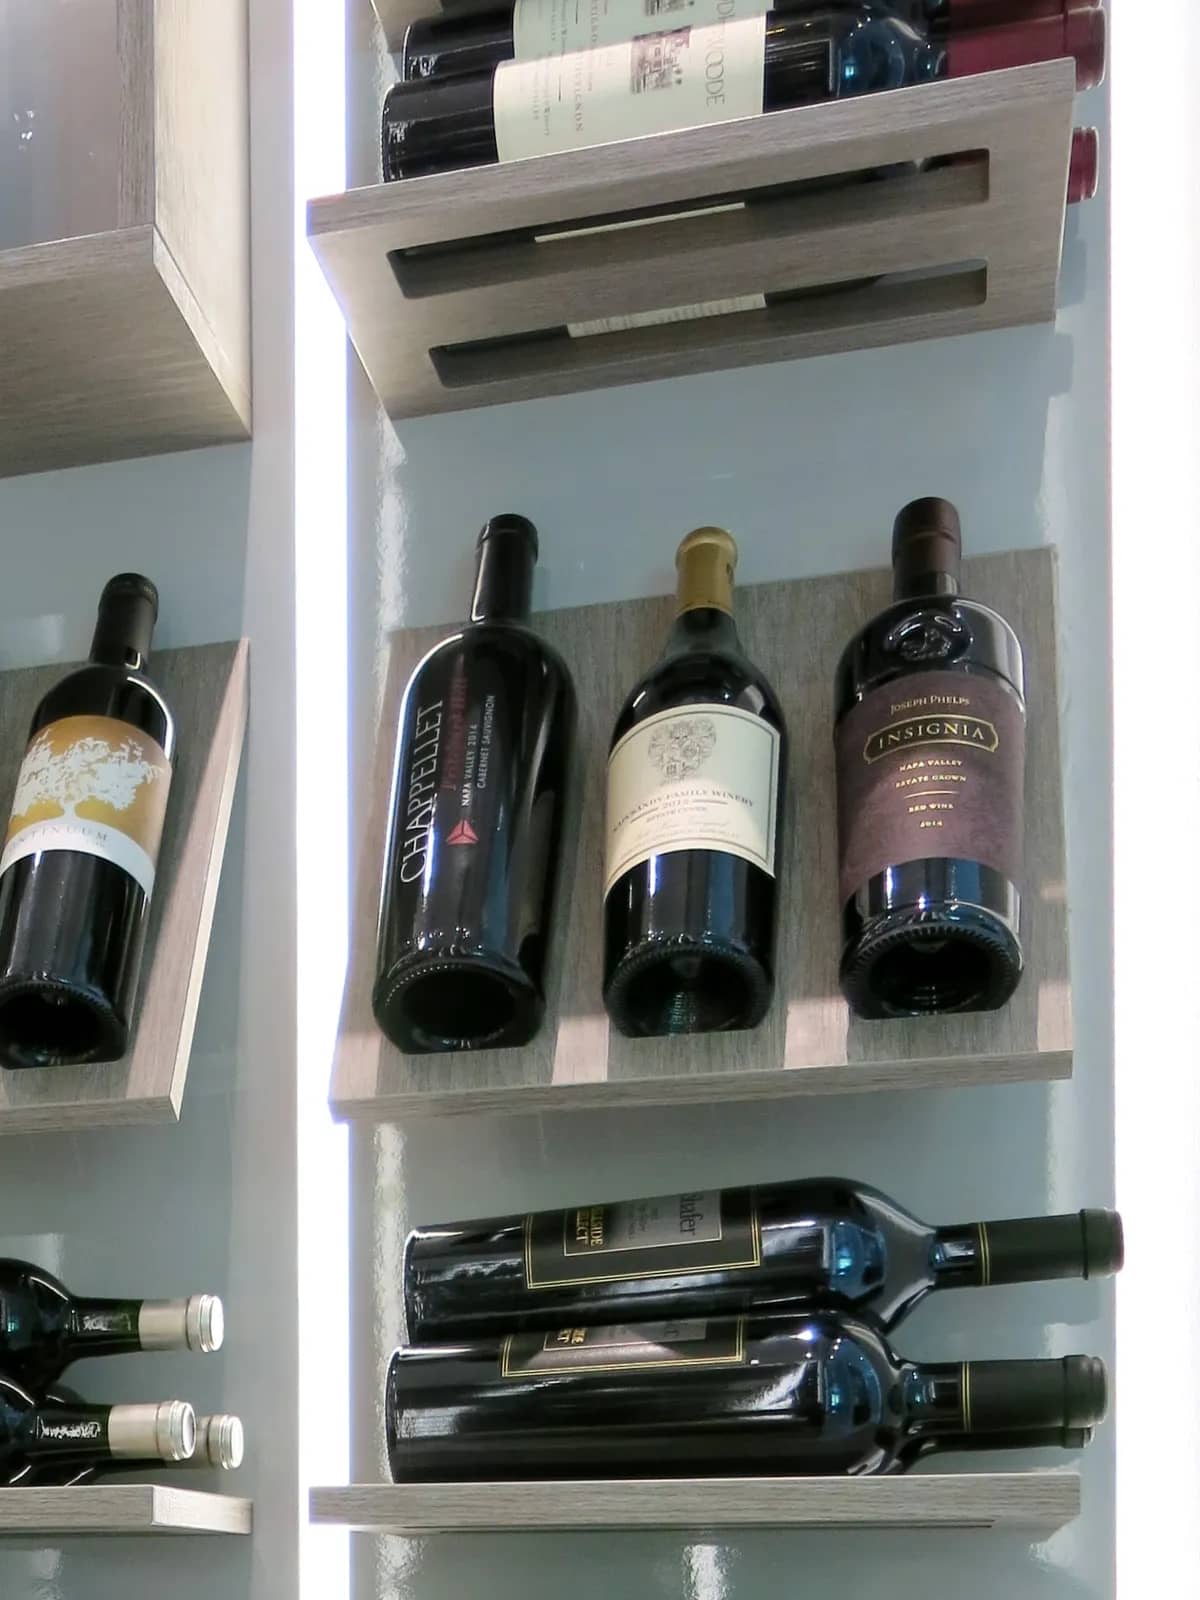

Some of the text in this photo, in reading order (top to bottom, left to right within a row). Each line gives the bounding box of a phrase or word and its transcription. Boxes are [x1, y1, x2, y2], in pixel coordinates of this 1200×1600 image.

[890, 694, 970, 715] JOSEPH PHELPS
[482, 694, 495, 745] SAUVIGNON
[878, 722, 985, 750] INSIGNIA
[465, 750, 477, 778] VALLEY
[899, 759, 963, 772] NAPA VALLEY
[400, 699, 444, 883] CHAPPELLET
[462, 779, 474, 807] NAPA
[895, 774, 968, 789] ESTATE GROWN
[711, 789, 754, 808] WINERY
[908, 802, 954, 814] RED WINE
